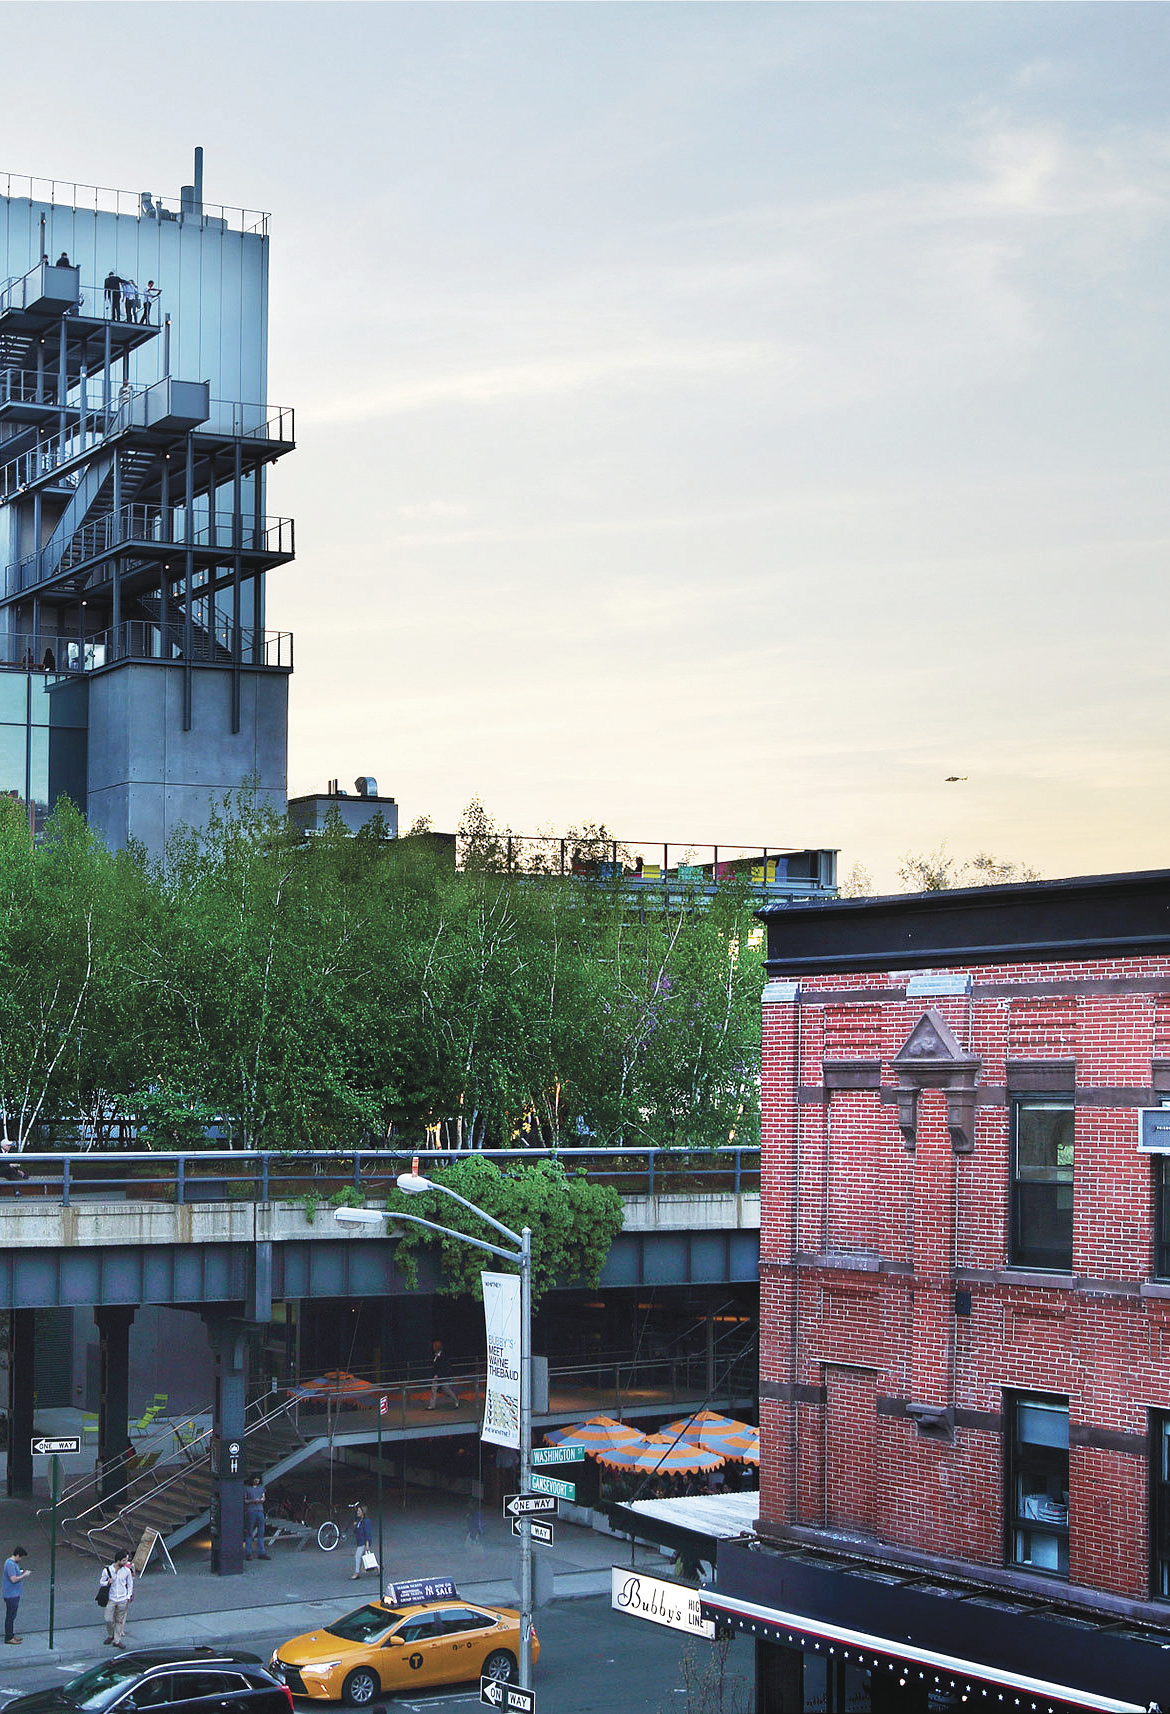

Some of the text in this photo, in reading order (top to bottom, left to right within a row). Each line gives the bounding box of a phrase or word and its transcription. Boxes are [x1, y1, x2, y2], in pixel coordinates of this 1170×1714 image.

[488, 1345, 504, 1358] MEET
[533, 1448, 576, 1464] WASHINGTON
[532, 1476, 567, 1497] GANSEVOORT
[513, 1498, 551, 1511] ONE WAY
[534, 1526, 548, 1538] WAY
[435, 1586, 453, 1596] SALE
[617, 1577, 683, 1624] Bubby's
[688, 1599, 701, 1613] HIG
[688, 1612, 705, 1629] LINE
[490, 1687, 527, 1708] ON WAY
